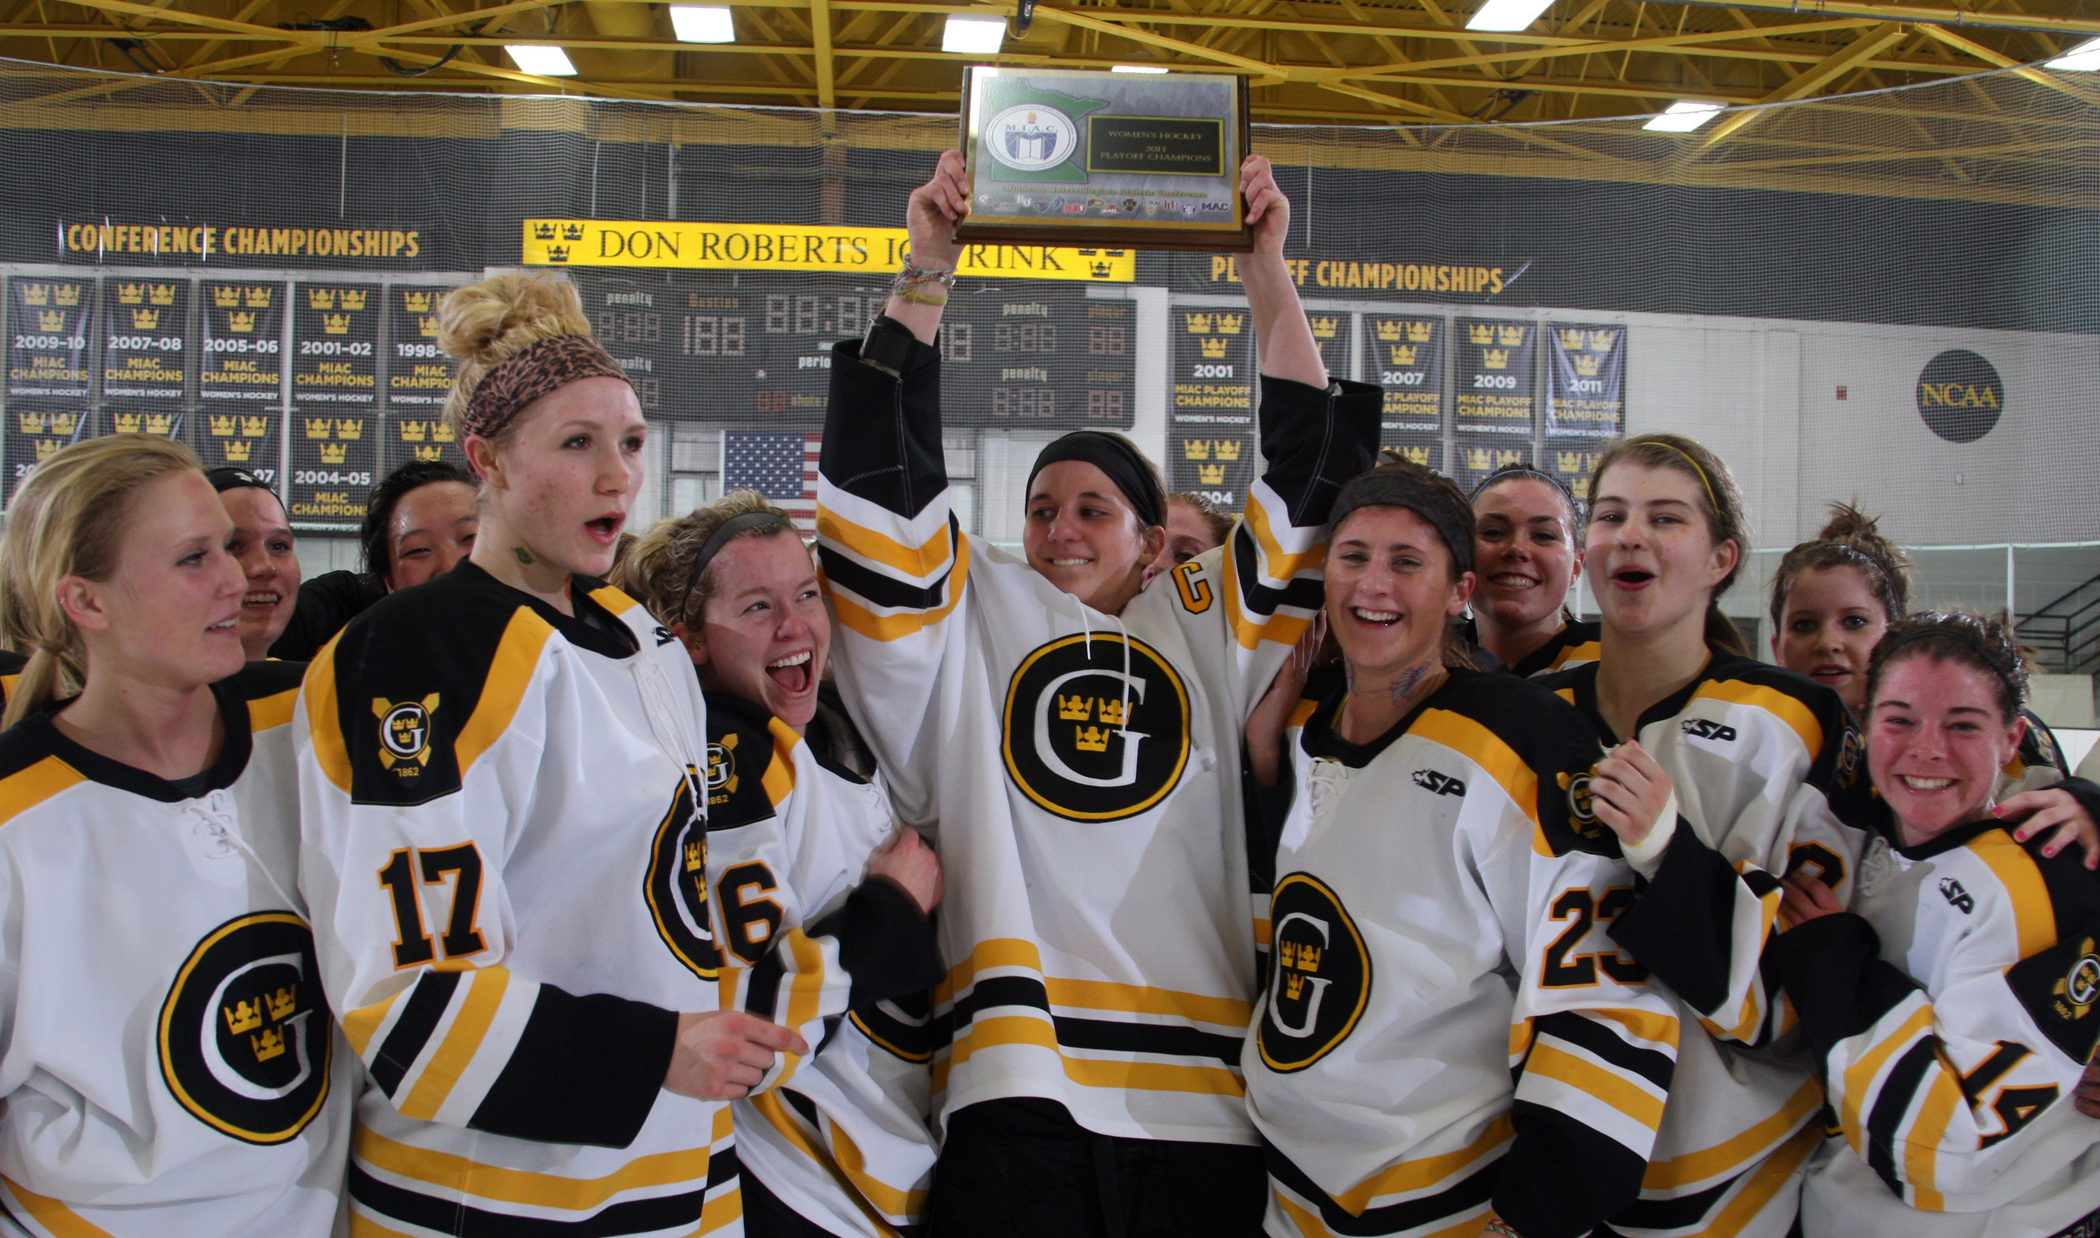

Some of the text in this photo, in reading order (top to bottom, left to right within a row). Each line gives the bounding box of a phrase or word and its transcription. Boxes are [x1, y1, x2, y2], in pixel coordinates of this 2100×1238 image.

[1005, 124, 1058, 132] M.I.A.C.
[1108, 130, 1204, 140] WOMEN'S HOCKEY
[1100, 152, 1212, 162] PLAYOFF CHAMPIONS
[1201, 202, 1229, 211] MAC
[67, 224, 420, 257] CONFERENCE CHAMPIONSHIPS
[598, 230, 682, 259] DON
[699, 232, 868, 265] ROBERTS
[966, 245, 1066, 271] RINK
[1211, 256, 1503, 294] PLFF CHAMPIONSHIPS
[607, 291, 652, 307] penalty
[1002, 302, 1048, 317] penalty
[15, 336, 86, 350] 2009-10
[108, 336, 182, 350] 2007-08
[204, 338, 278, 354] 2005-06
[301, 341, 372, 356] 2001-02
[397, 344, 452, 358] 1998-
[33, 357, 66, 368] MIAC
[128, 358, 160, 370] MIAC
[224, 360, 256, 372] MIAC
[318, 362, 352, 374] MIAC
[799, 356, 831, 370] perio
[10, 369, 88, 381] CHAMPIONS
[105, 370, 183, 382] CHAMPIONS
[414, 365, 447, 377] MIAC
[1002, 367, 1048, 383] penalty
[1194, 364, 1233, 378] 2001
[201, 372, 279, 384] CHAMPIONS
[296, 374, 374, 386] CHAMPIONS
[391, 376, 456, 389] CHAMPIO
[1382, 372, 1424, 386] 2007
[1474, 374, 1516, 390] 2009
[10, 388, 88, 397] WOMEN'S HOCKEY
[104, 388, 183, 398] WOMEN'S HOCKEY
[1175, 384, 1251, 396] MIAC PLAYOFF
[1569, 380, 1602, 394] 2011
[201, 390, 279, 400] WOMEN'S HOCKEY
[296, 392, 374, 403] WOMEN'S HOCKEY
[390, 396, 432, 404] WOMEN'S
[1394, 392, 1440, 402] PLAYOFF
[1457, 395, 1532, 406] MIAC PLAYOFF
[1921, 383, 2000, 408] NCAA
[1176, 396, 1250, 408] CHAMPIONS
[1549, 398, 1622, 410] MIAC PLAYOFF
[1382, 403, 1439, 414] AMPIONS
[1458, 406, 1531, 418] CHAMPIONS
[1175, 415, 1250, 424] WOMEN'S HOCKEY
[1550, 409, 1620, 422] CHAMPIONS
[1407, 422, 1439, 431] HOCKEY
[1457, 425, 1532, 435] WOMEN'S HOCKEY
[294, 470, 371, 486] 2004-05
[315, 492, 349, 504] MIAC
[1169, 561, 1214, 615] C
[376, 839, 489, 971] 17
